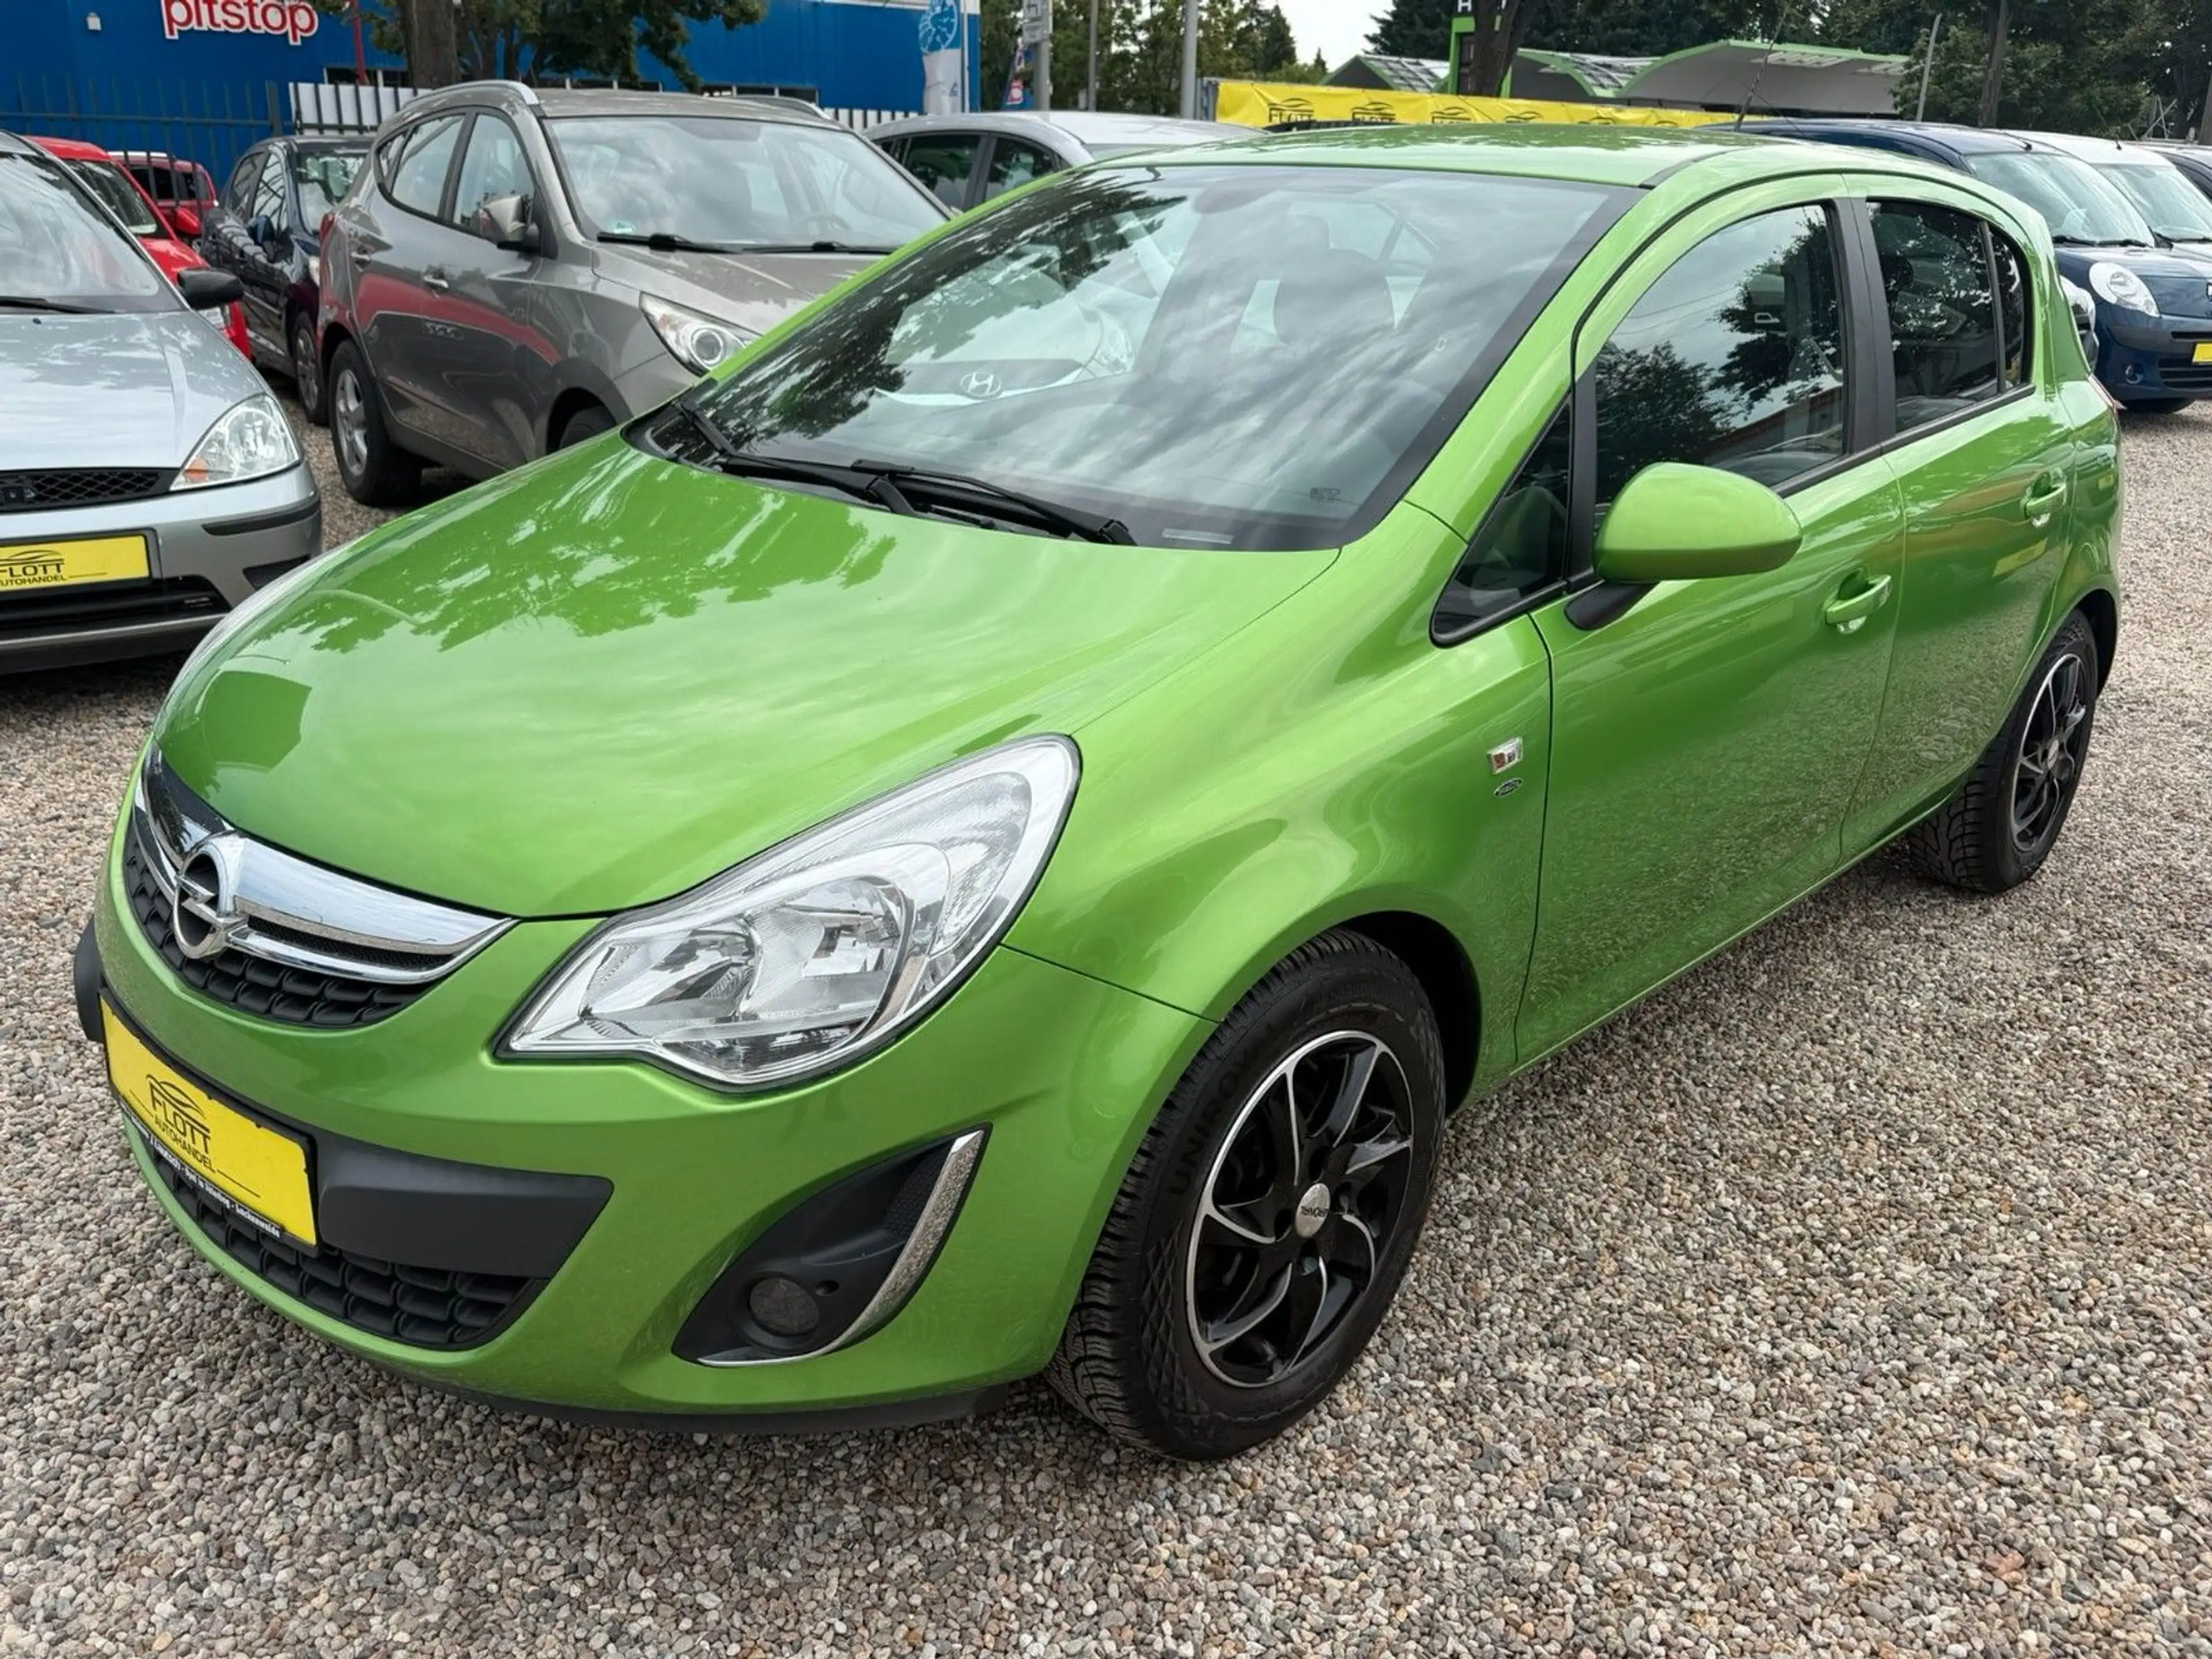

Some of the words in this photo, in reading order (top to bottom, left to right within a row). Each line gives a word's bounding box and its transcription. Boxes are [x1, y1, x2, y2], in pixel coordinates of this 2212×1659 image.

[162, 0, 317, 44] pitstop
[150, 1082, 211, 1154] FLOTT
[154, 1115, 216, 1174] AUTOHANDEL
